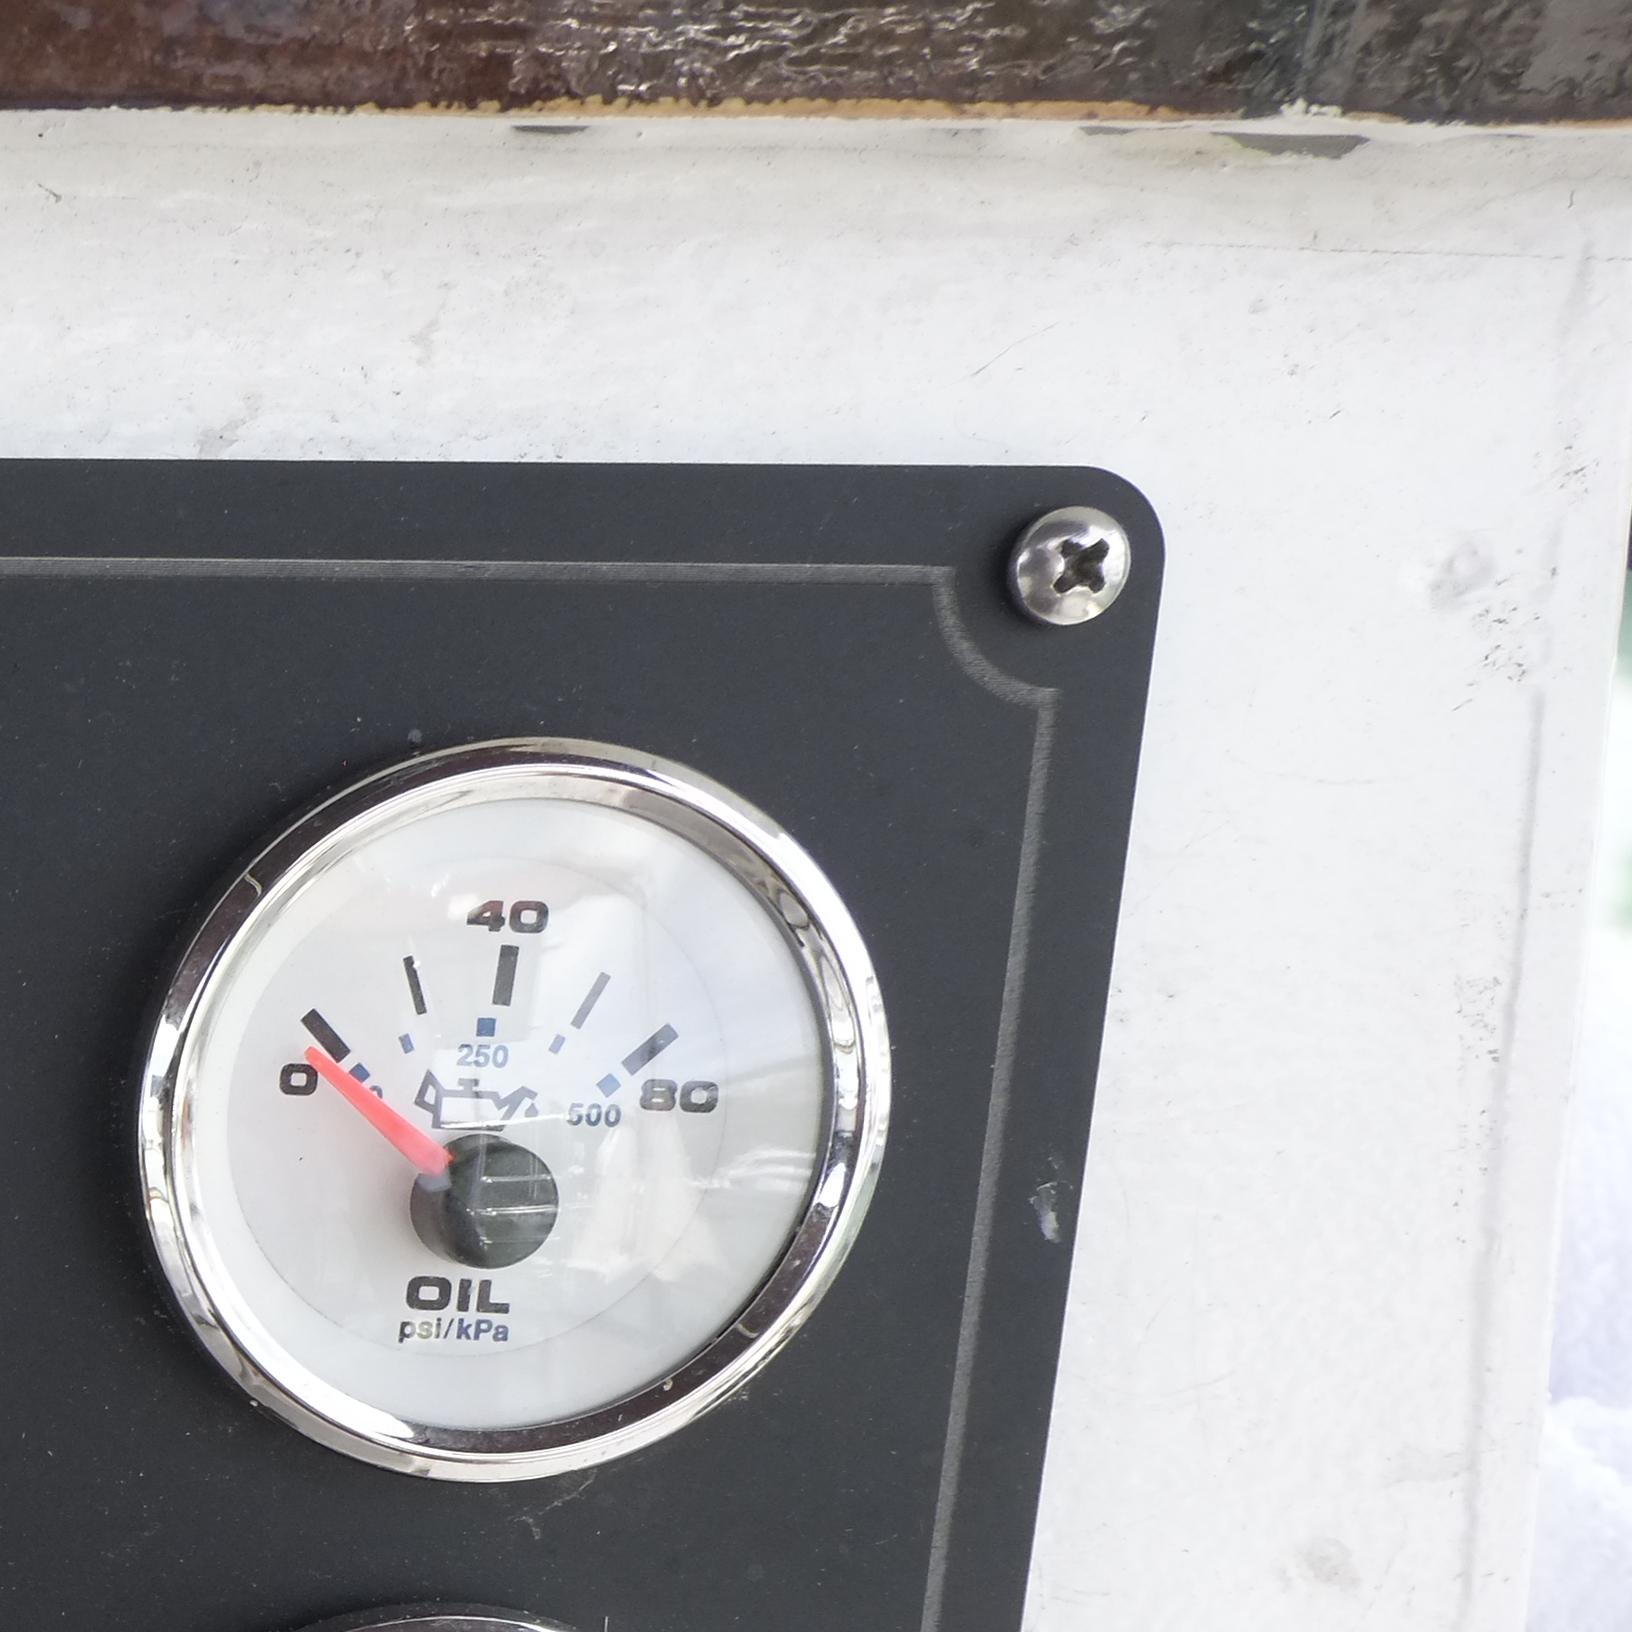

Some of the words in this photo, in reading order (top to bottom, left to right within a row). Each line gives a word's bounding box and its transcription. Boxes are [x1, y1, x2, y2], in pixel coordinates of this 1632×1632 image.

[467, 900, 547, 932] 40
[457, 1044, 508, 1067] 250
[280, 1063, 317, 1095] 0
[639, 1079, 718, 1112] 80
[567, 1103, 620, 1127] 500
[405, 1276, 509, 1313] OIL
[398, 1318, 508, 1343] psi/kPa
